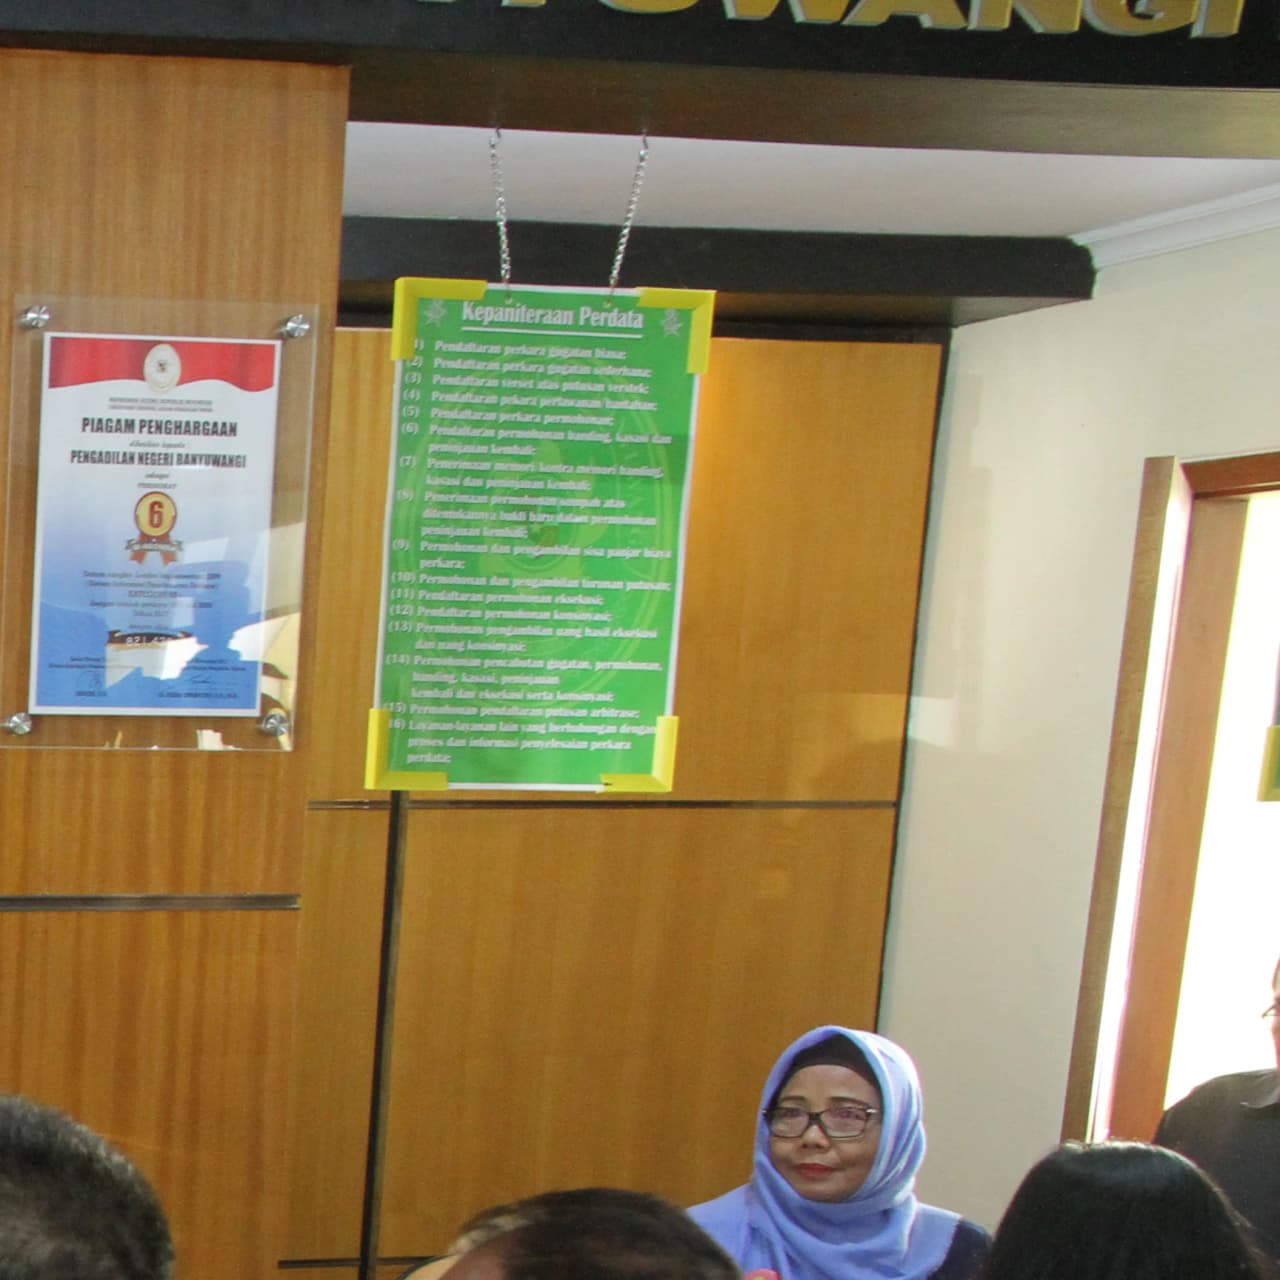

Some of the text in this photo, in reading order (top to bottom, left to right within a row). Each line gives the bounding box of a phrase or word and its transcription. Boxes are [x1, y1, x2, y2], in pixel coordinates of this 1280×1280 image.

[462, 301, 643, 328] Kepaniteraan Perdata
[82, 417, 237, 436] PIAGAM PENGHARGAAN
[71, 450, 246, 468] PENGADILAN NEGERI BANYUWANGI
[148, 501, 163, 528] 6
